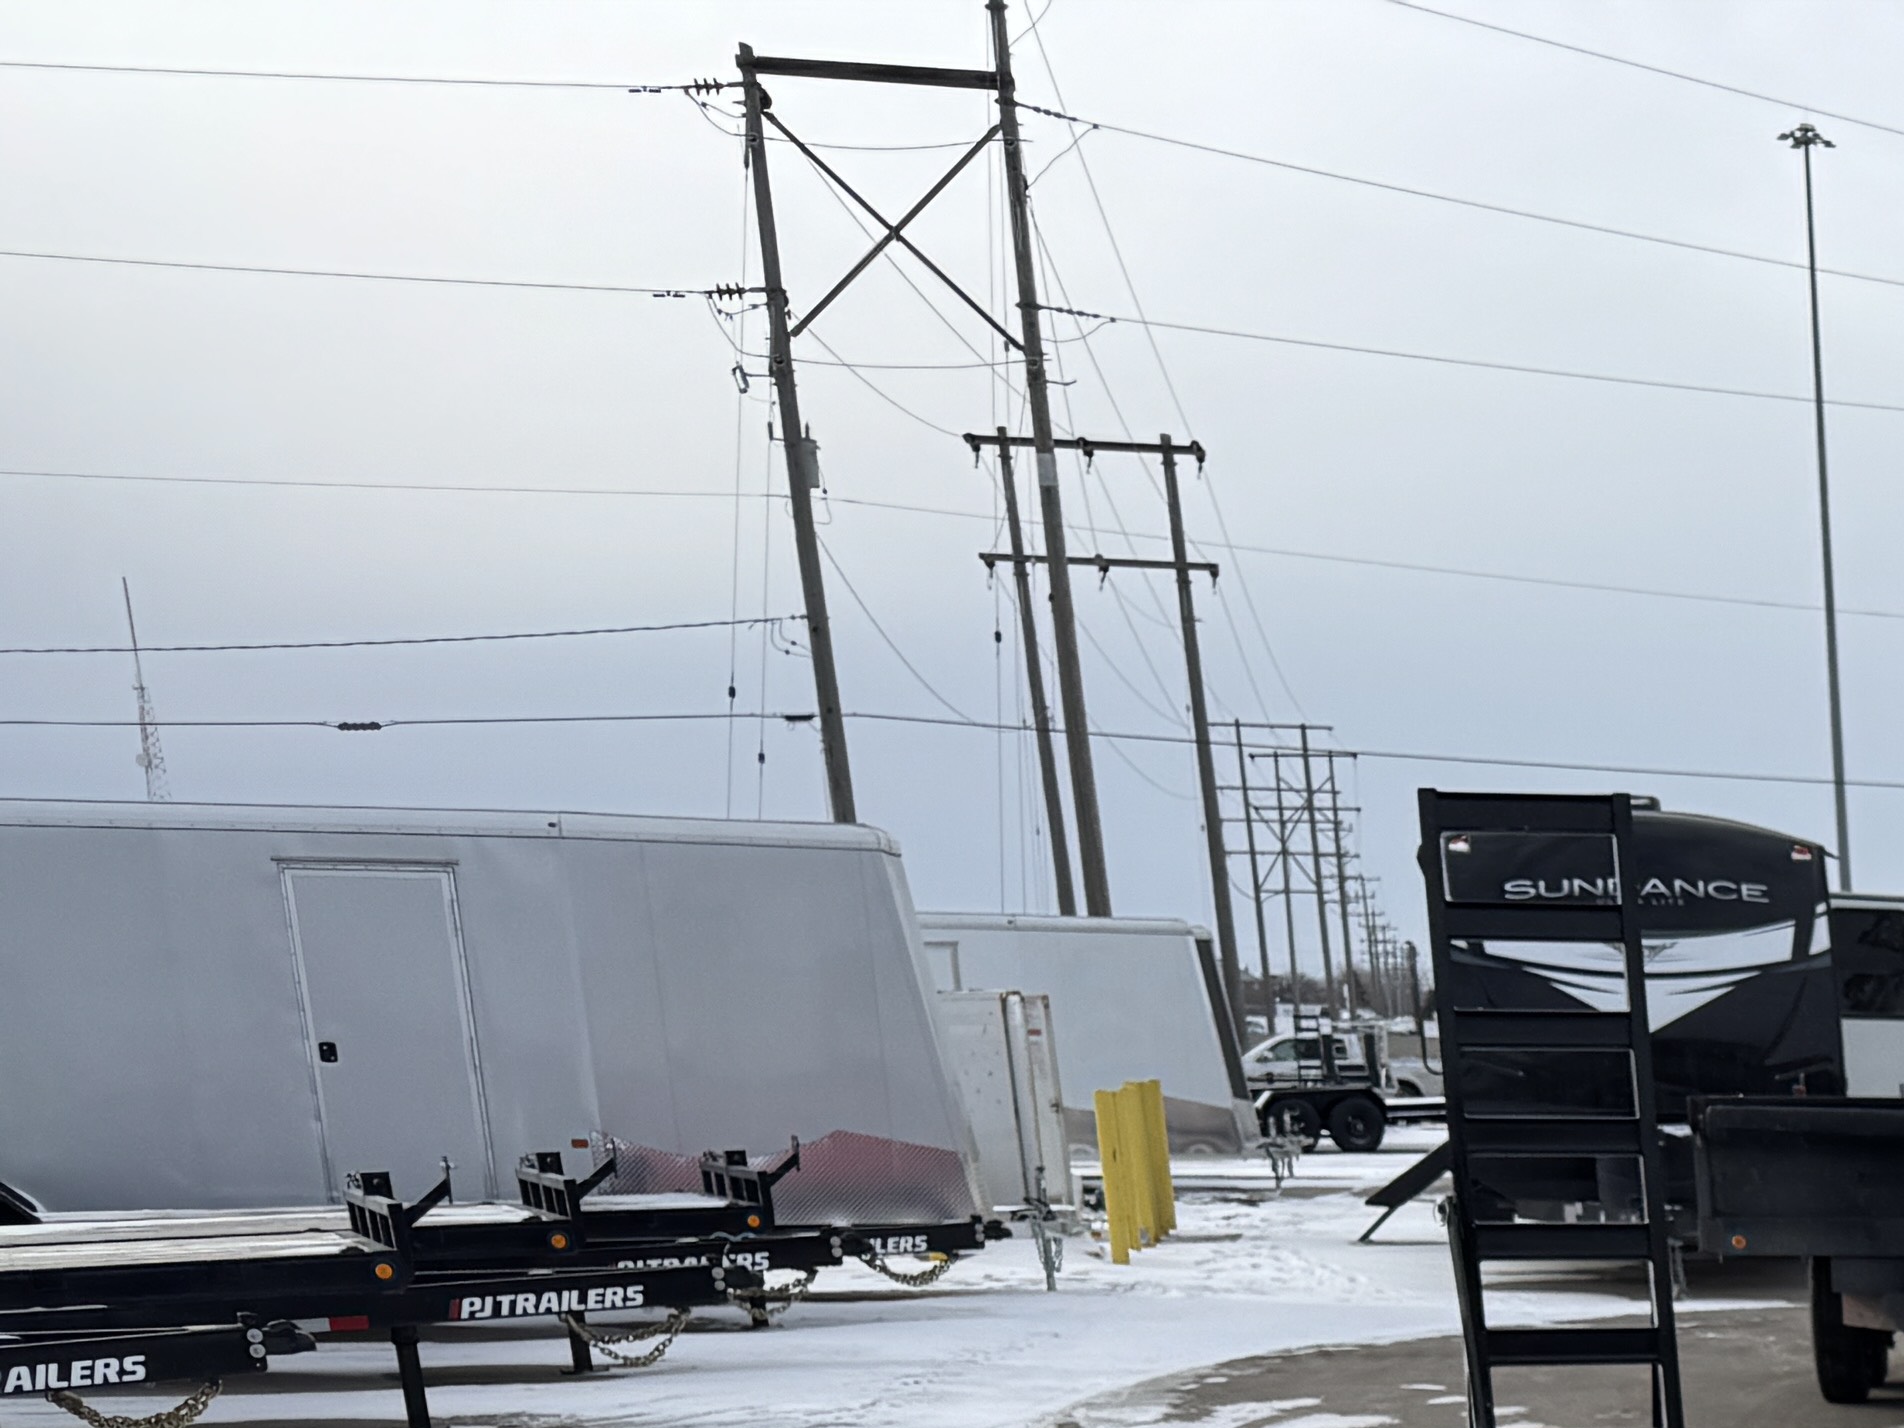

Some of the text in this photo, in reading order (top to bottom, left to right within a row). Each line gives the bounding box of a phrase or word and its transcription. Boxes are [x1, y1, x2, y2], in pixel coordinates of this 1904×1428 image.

[460, 1285, 644, 1320] PJ TRAILERS
[0, 1355, 147, 1394] AILERS
